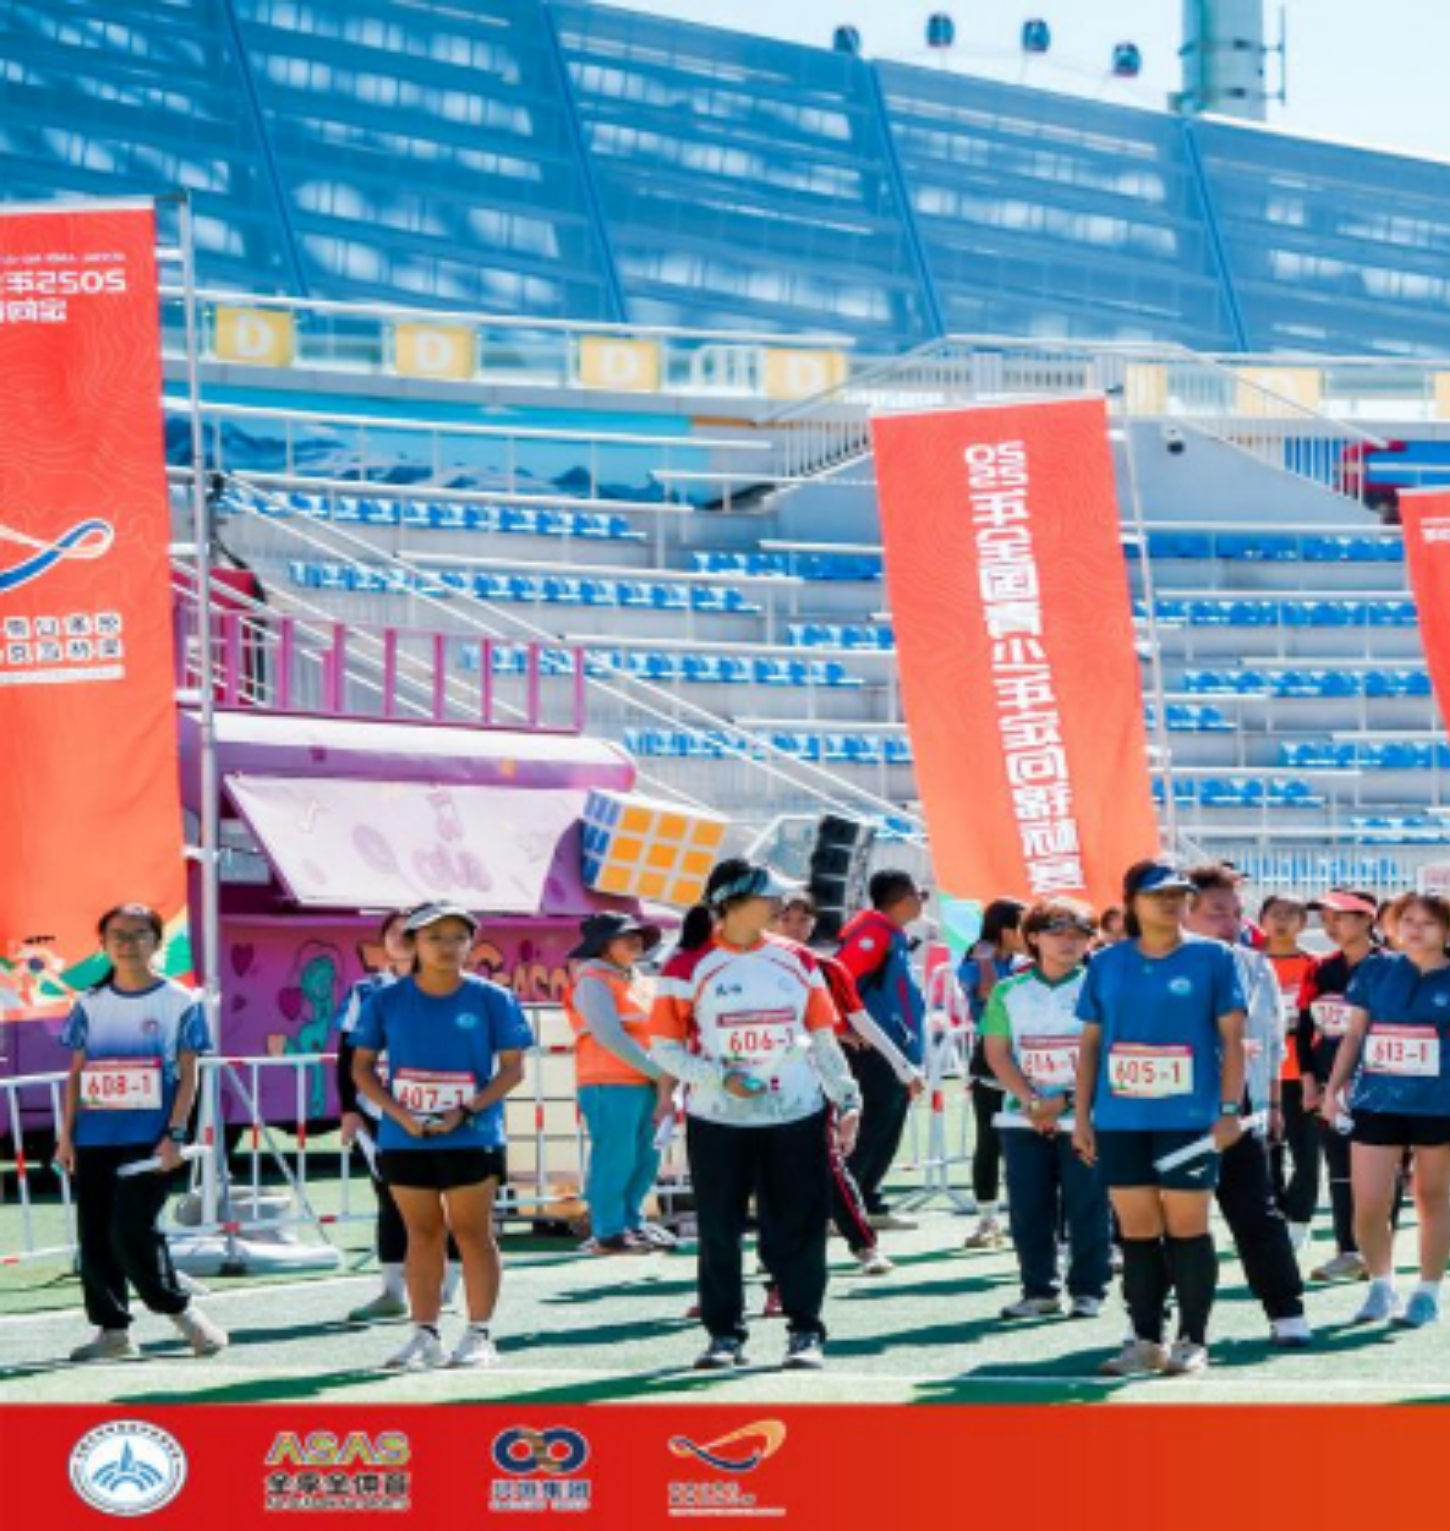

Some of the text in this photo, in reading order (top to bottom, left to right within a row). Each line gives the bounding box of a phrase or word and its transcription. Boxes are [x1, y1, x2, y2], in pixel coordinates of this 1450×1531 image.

[234, 315, 272, 356] D
[415, 330, 454, 371] D
[600, 343, 640, 384] D
[788, 355, 826, 394] D
[729, 1027, 794, 1053] 606-1
[1375, 1041, 1428, 1062] 613-1
[86, 1062, 153, 1098] 608-1
[1115, 1059, 1181, 1084] 605-1
